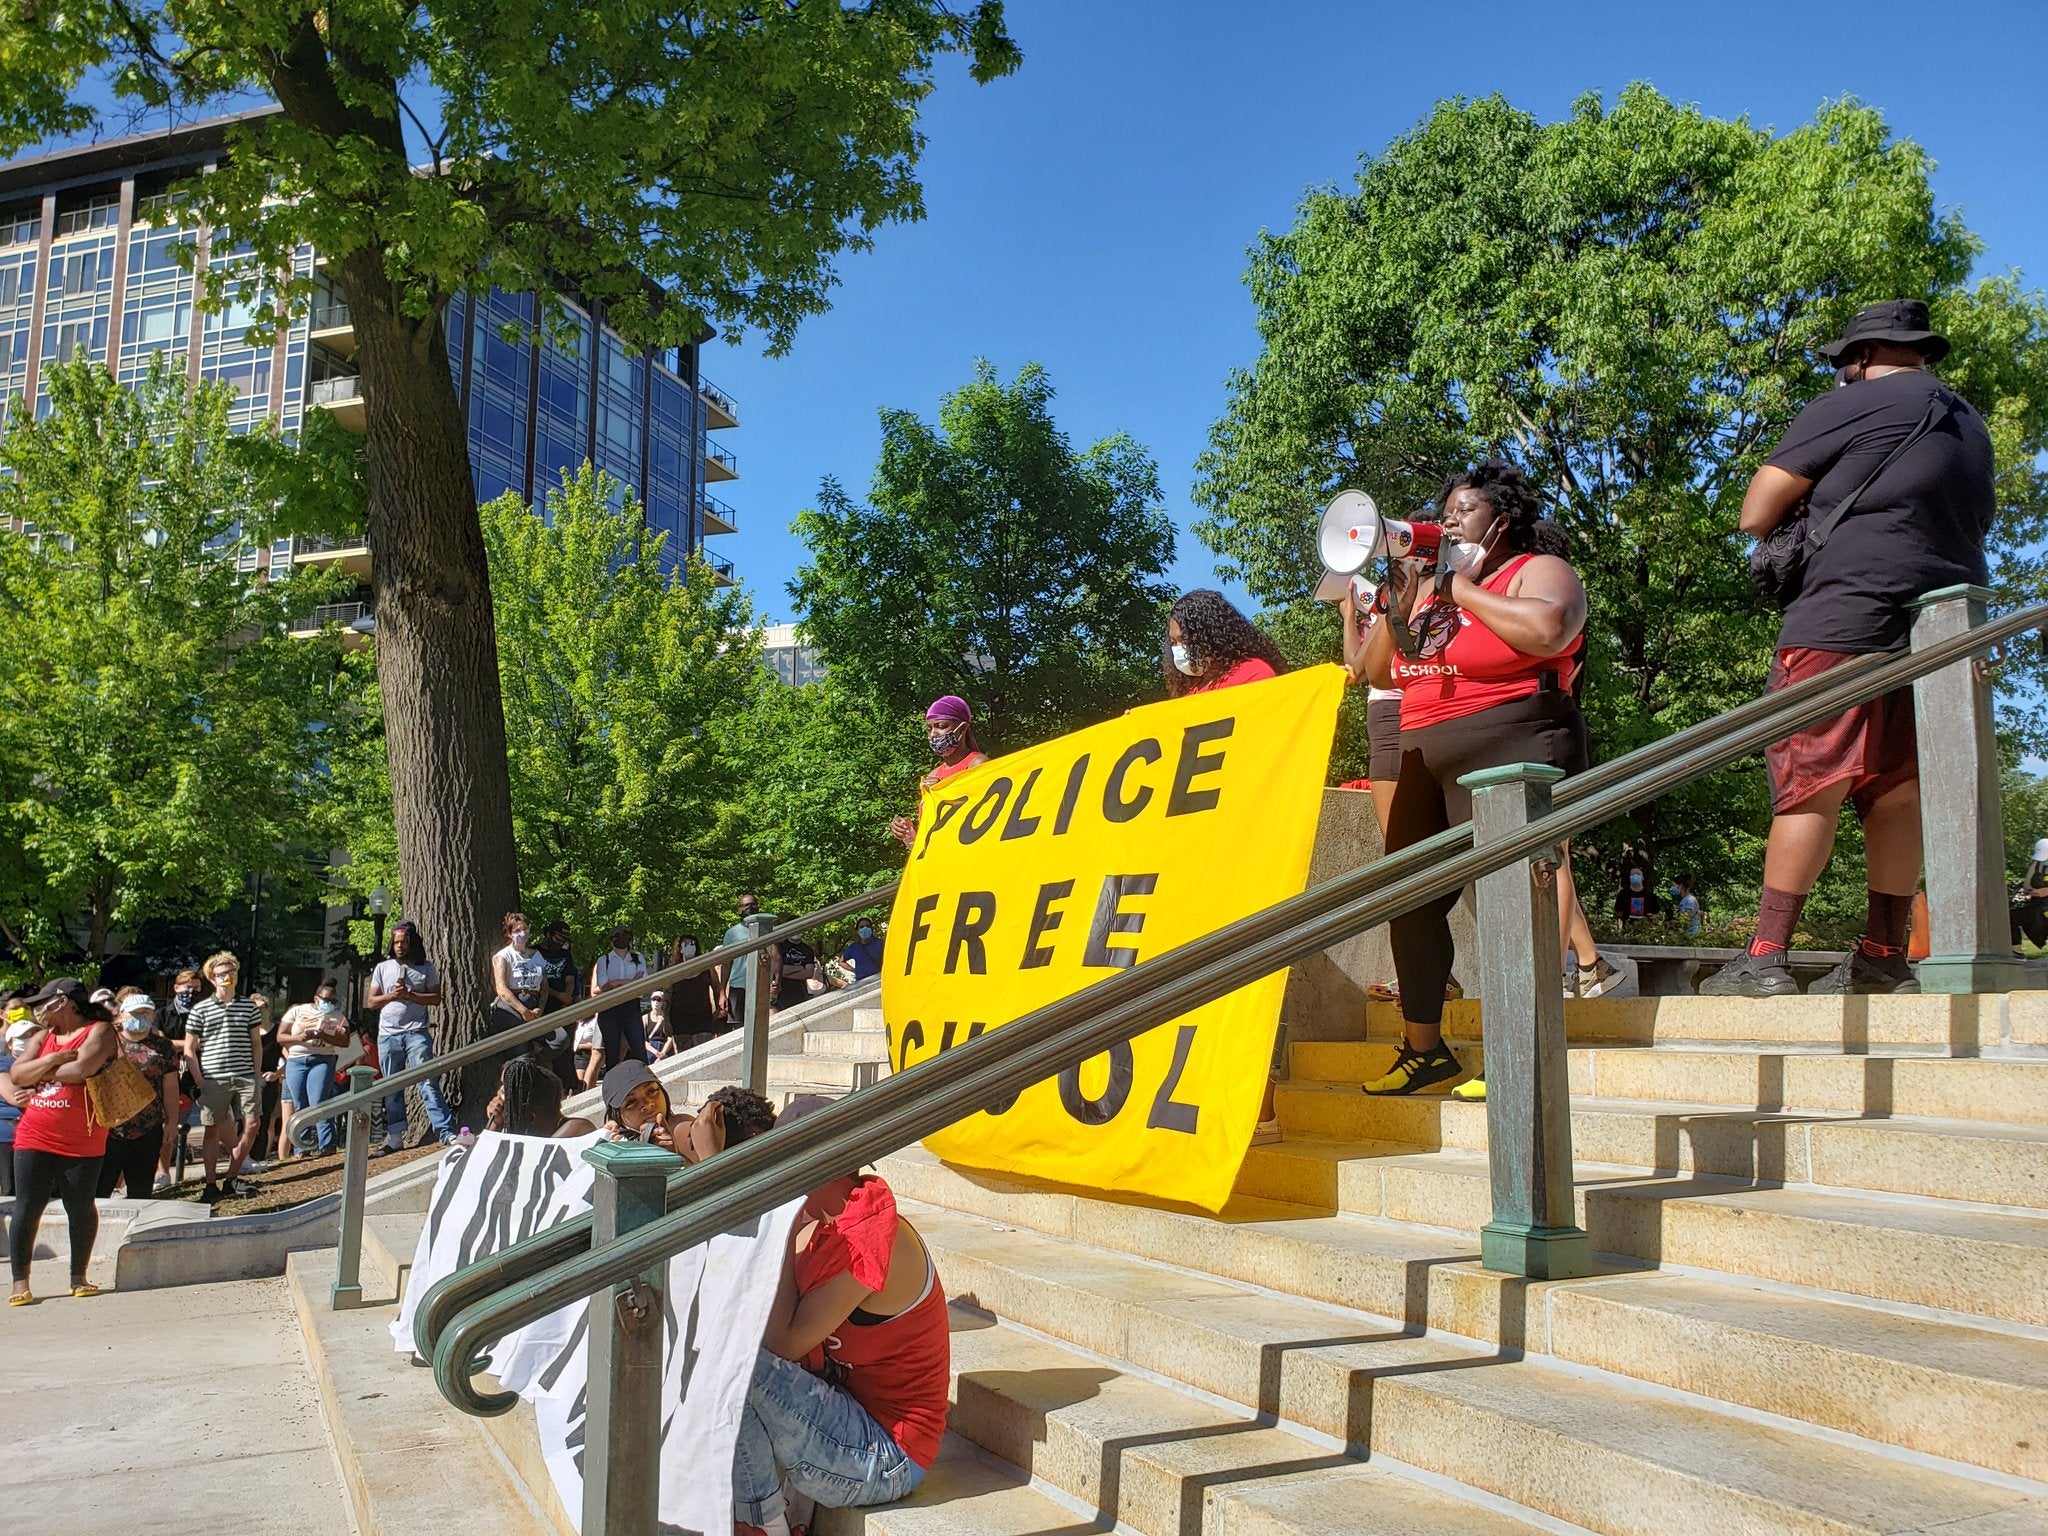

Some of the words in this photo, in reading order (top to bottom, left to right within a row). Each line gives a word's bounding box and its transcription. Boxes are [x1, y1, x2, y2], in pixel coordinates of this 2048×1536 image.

[1399, 664, 1463, 678] SCHOOL
[917, 716, 1236, 860] POLICE
[904, 872, 1160, 977] FREE
